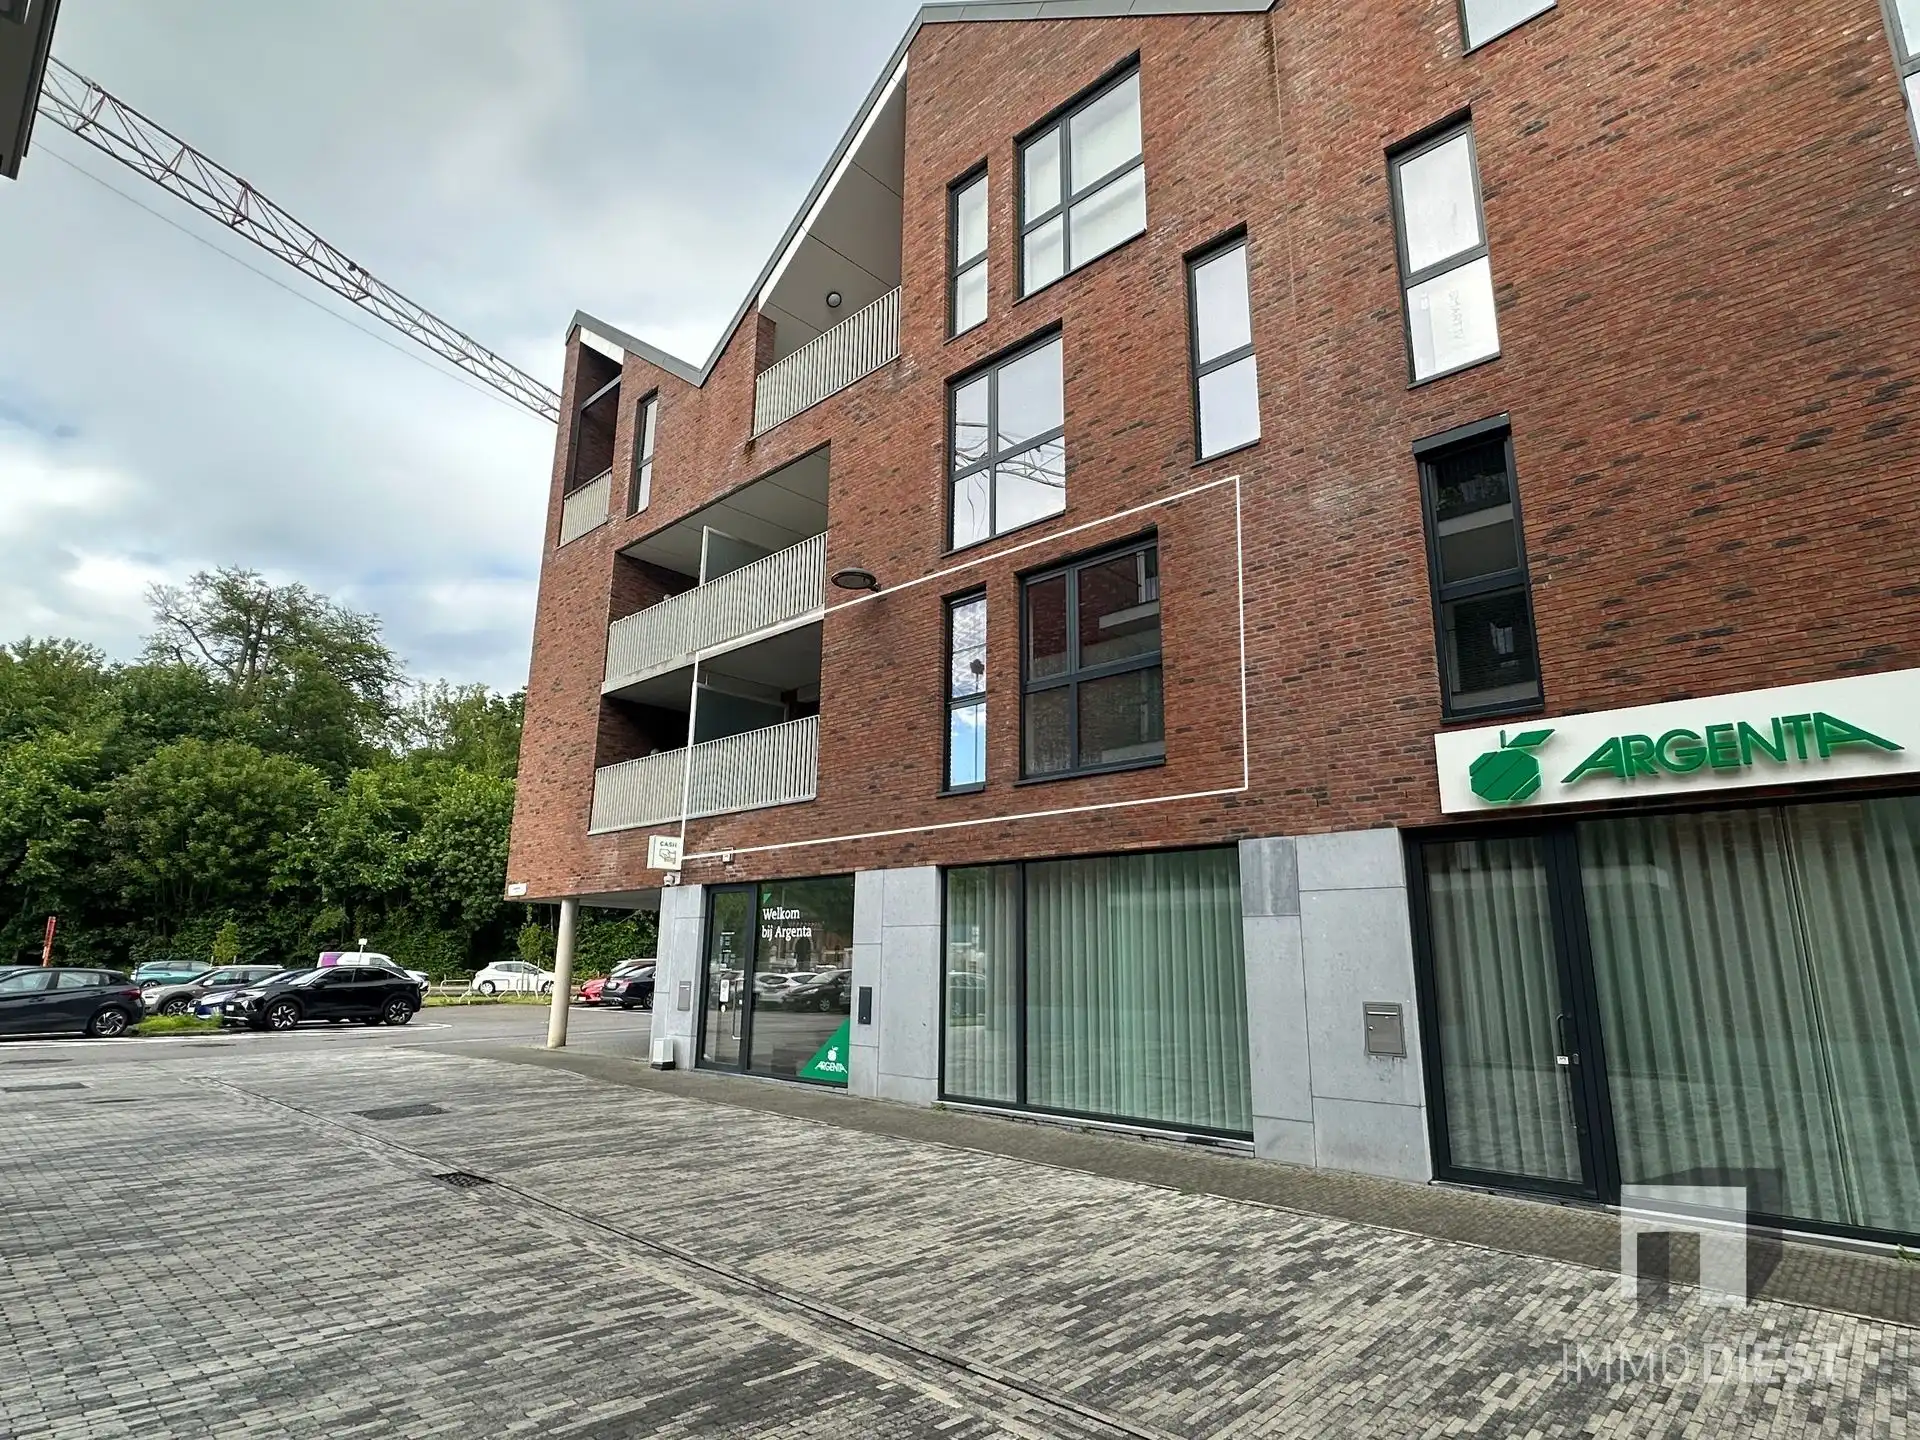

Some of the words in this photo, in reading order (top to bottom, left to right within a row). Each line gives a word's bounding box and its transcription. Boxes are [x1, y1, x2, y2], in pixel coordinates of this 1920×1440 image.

[1560, 711, 1906, 784] ARGENTA
[659, 840, 678, 848] CASH
[762, 906, 801, 921] Welkom
[761, 924, 773, 942] bij
[774, 925, 812, 942] Argenta
[814, 1060, 848, 1074] ARGENTA
